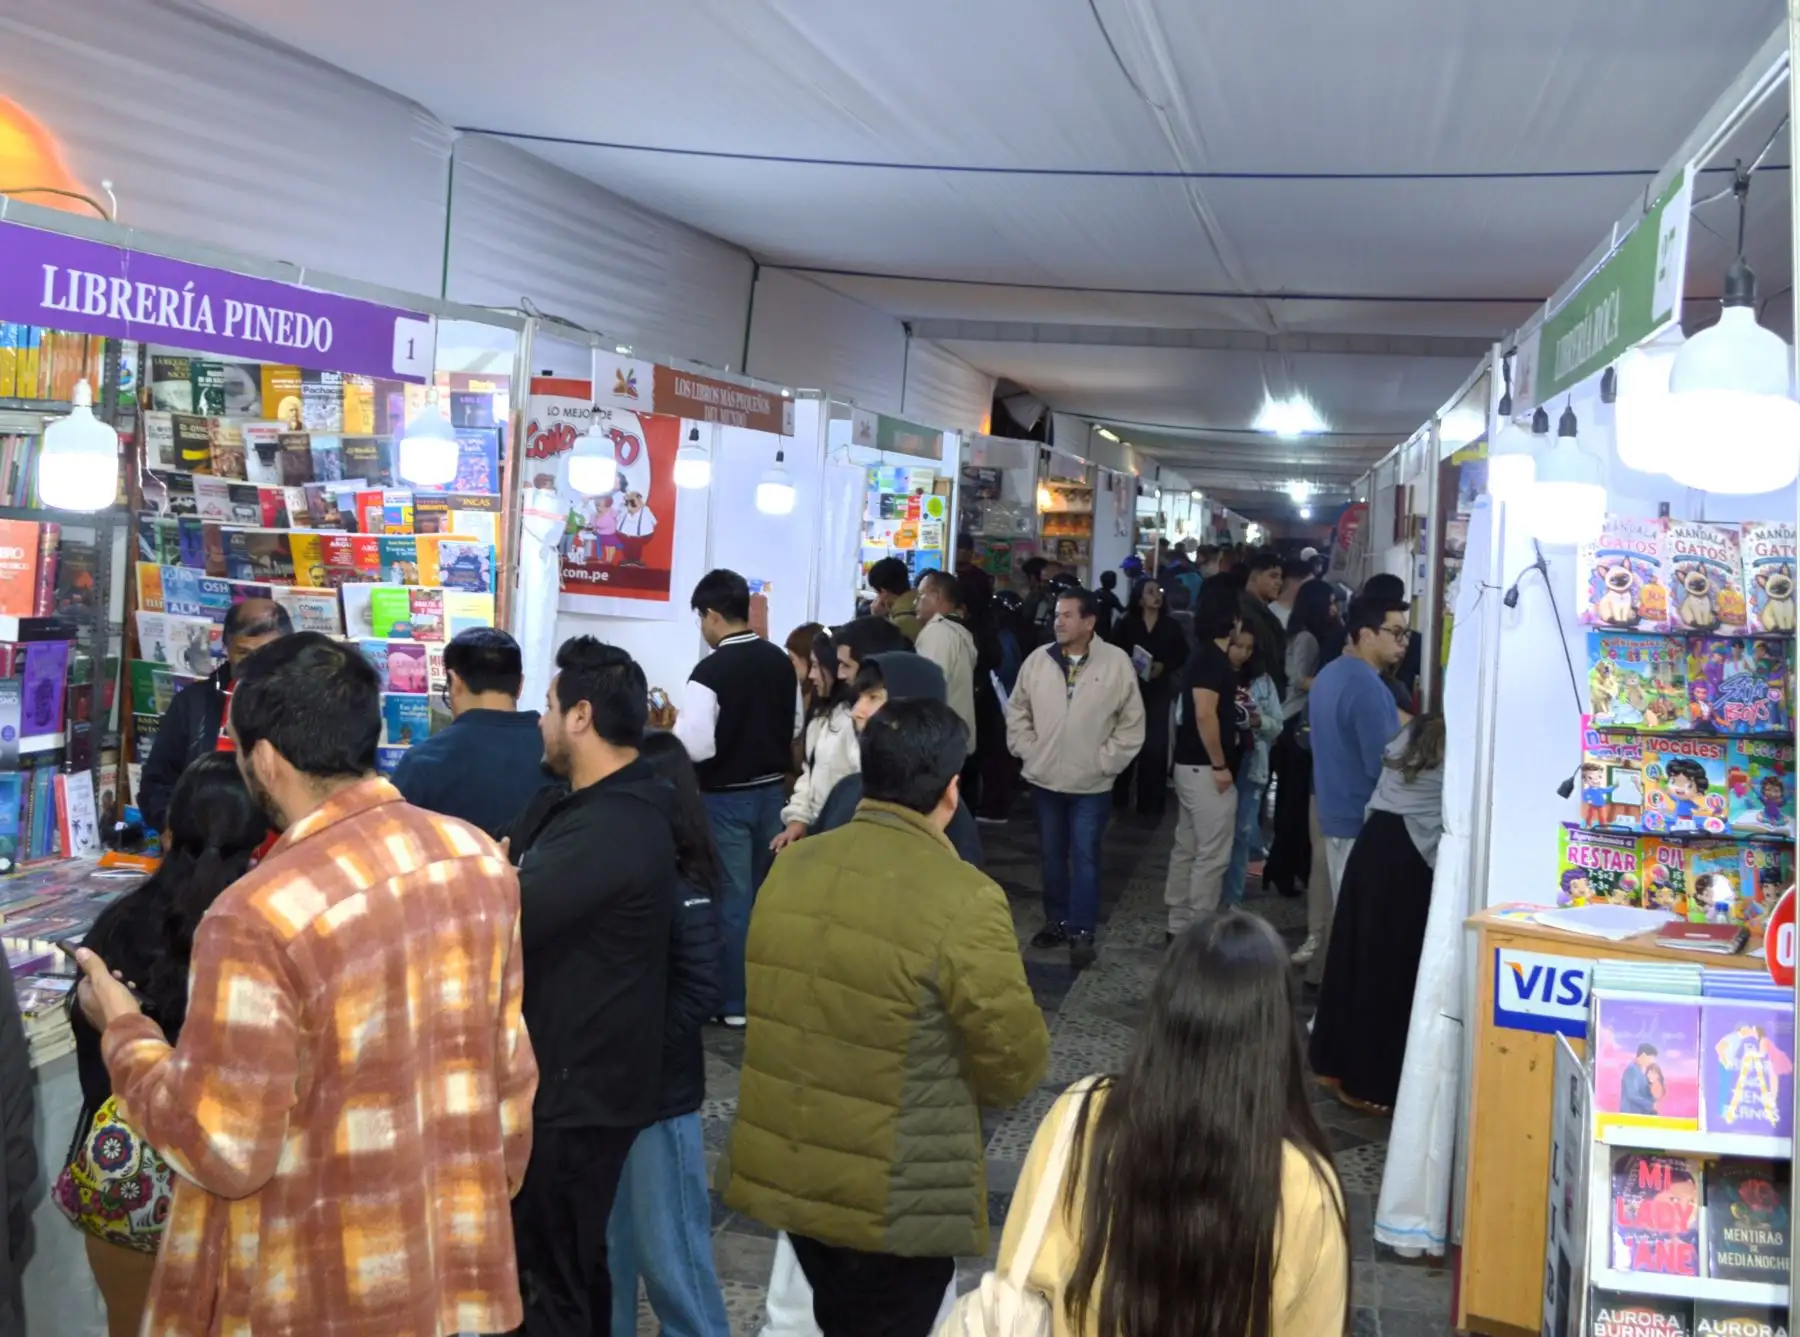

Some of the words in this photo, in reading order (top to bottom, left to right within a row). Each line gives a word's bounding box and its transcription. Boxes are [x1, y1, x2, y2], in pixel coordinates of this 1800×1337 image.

[40, 263, 216, 335] LIBRERÍA
[222, 299, 334, 353] PINEDO
[405, 337, 416, 361] 1
[674, 376, 691, 399] LOS
[691, 381, 719, 404] LIBROS
[720, 386, 735, 408] MÁS
[736, 393, 771, 415] PEQUEÑOS
[547, 406, 560, 417] LO
[704, 404, 718, 423] DEL
[720, 408, 747, 428] MUNDO
[1674, 529, 1727, 547] MANDALA
[1674, 540, 1728, 562] GATOS
[1650, 737, 1721, 759] vocales
[1567, 846, 1636, 872] RESTAR
[1503, 960, 1590, 1007] VIS
[1638, 1159, 1673, 1191] MI
[1616, 1196, 1695, 1233] LADY
[1723, 1228, 1784, 1246] MENTIRAS
[1597, 1308, 1681, 1330] AURORA
